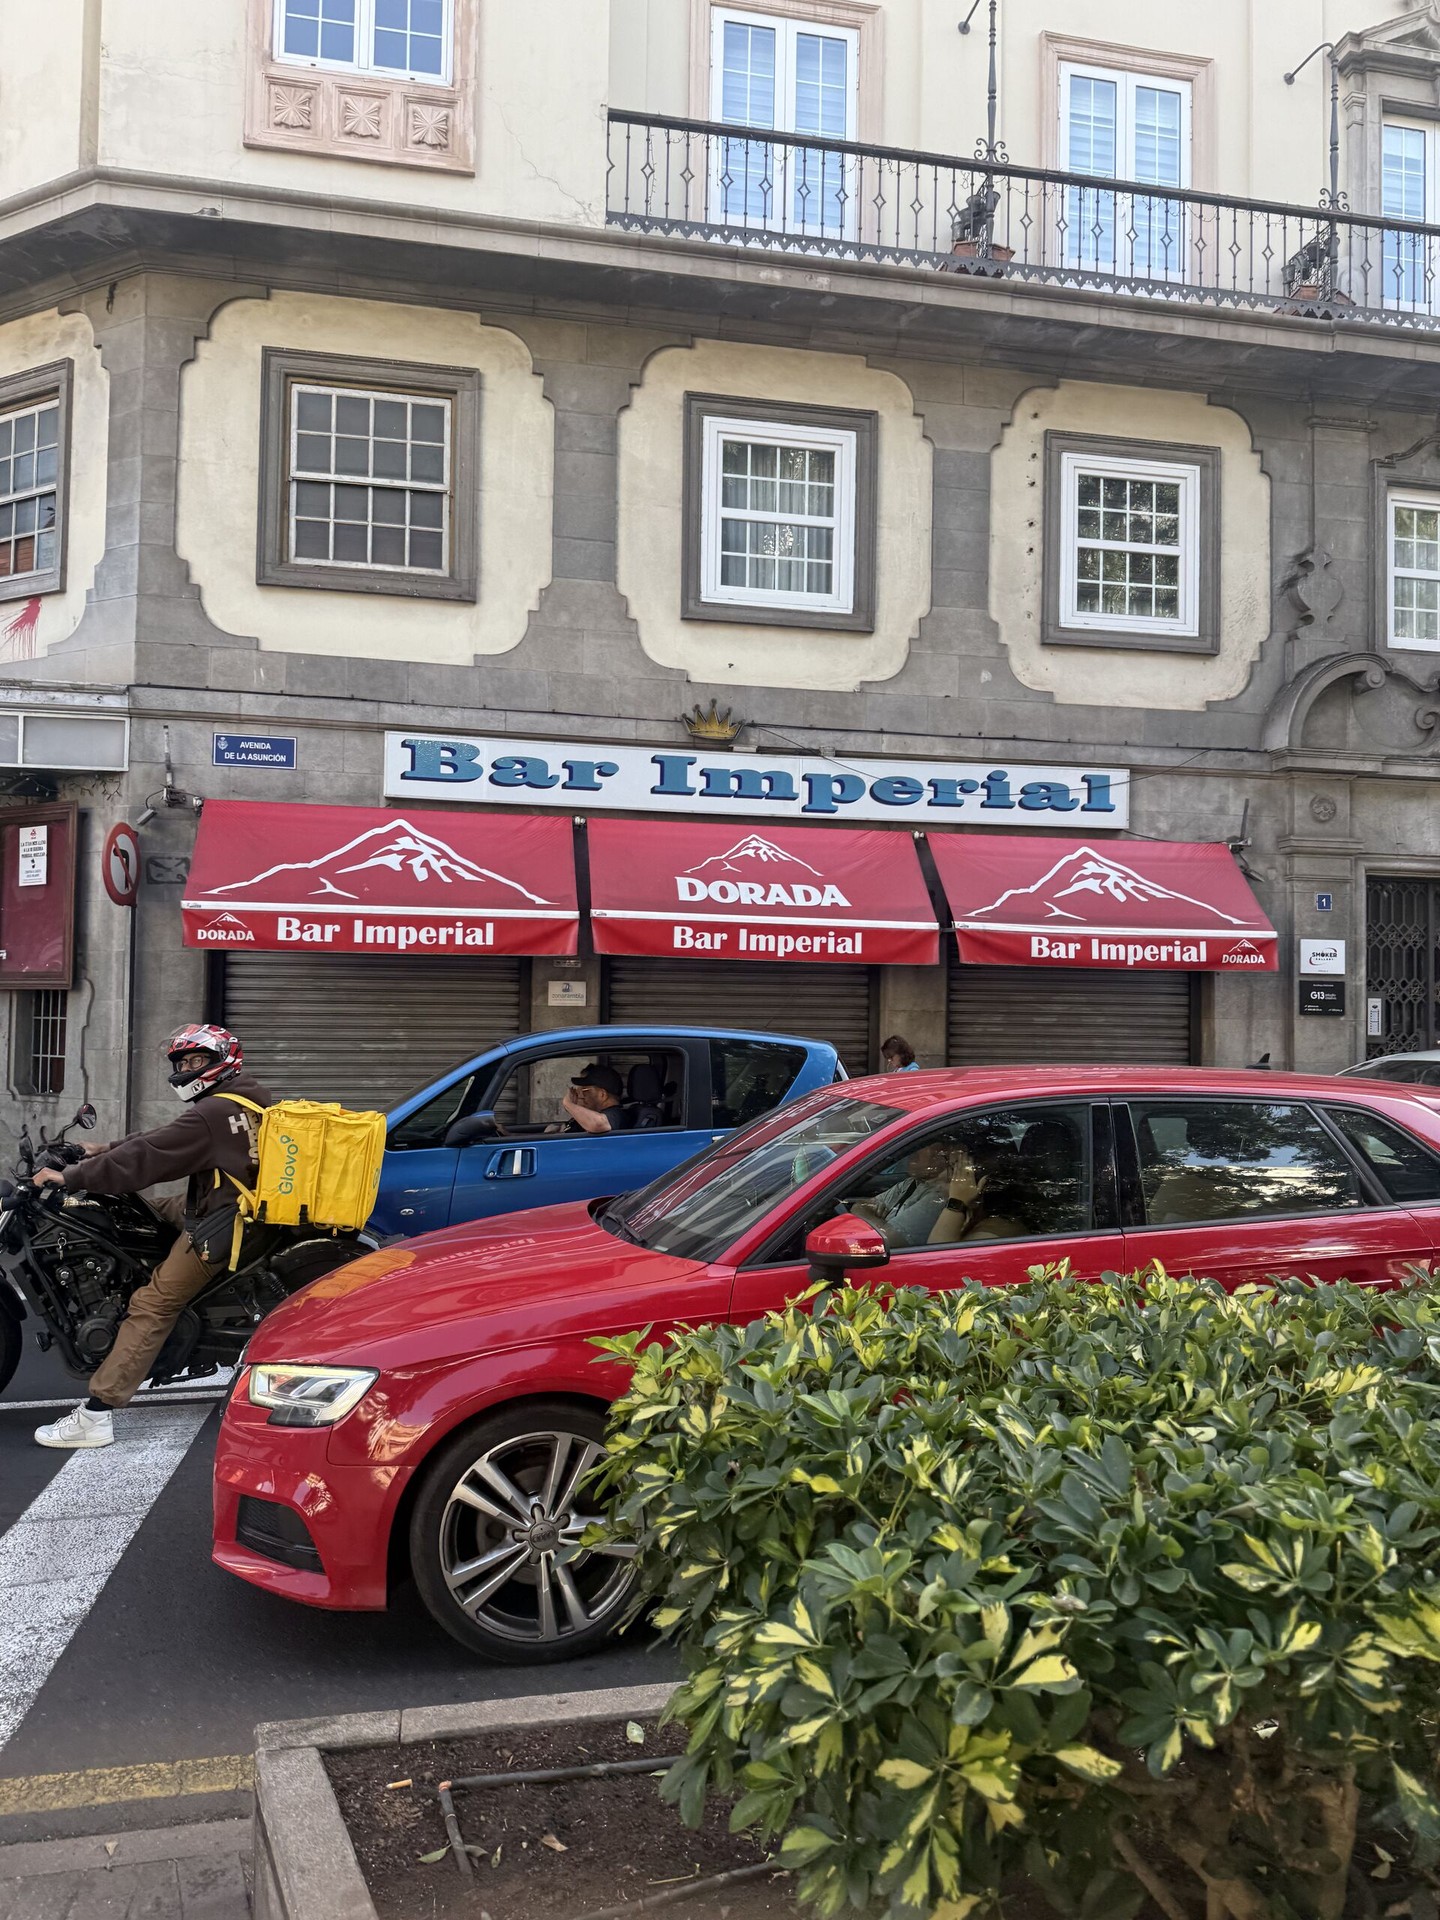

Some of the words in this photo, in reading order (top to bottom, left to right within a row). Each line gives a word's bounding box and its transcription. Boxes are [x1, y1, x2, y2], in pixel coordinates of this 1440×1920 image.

[240, 741, 272, 750] AVENIDA
[224, 752, 235, 760] DE
[236, 752, 247, 760] LA
[247, 752, 287, 762] ASUNCIÓN
[400, 738, 620, 791] Bar
[650, 754, 1116, 813] Imperial
[674, 876, 852, 907] DORADA
[1321, 897, 1326, 907] 1
[197, 929, 255, 941] DORADA
[277, 917, 341, 942] Bar
[353, 919, 494, 950] Imperial
[673, 926, 728, 950] Bar
[739, 928, 862, 957] Imperial
[1031, 936, 1081, 959] Bar
[1091, 938, 1207, 965] Imperial
[1221, 954, 1266, 964] DORADA
[1310, 991, 1325, 1000] G13
[279, 1143, 299, 1194] Glovo
